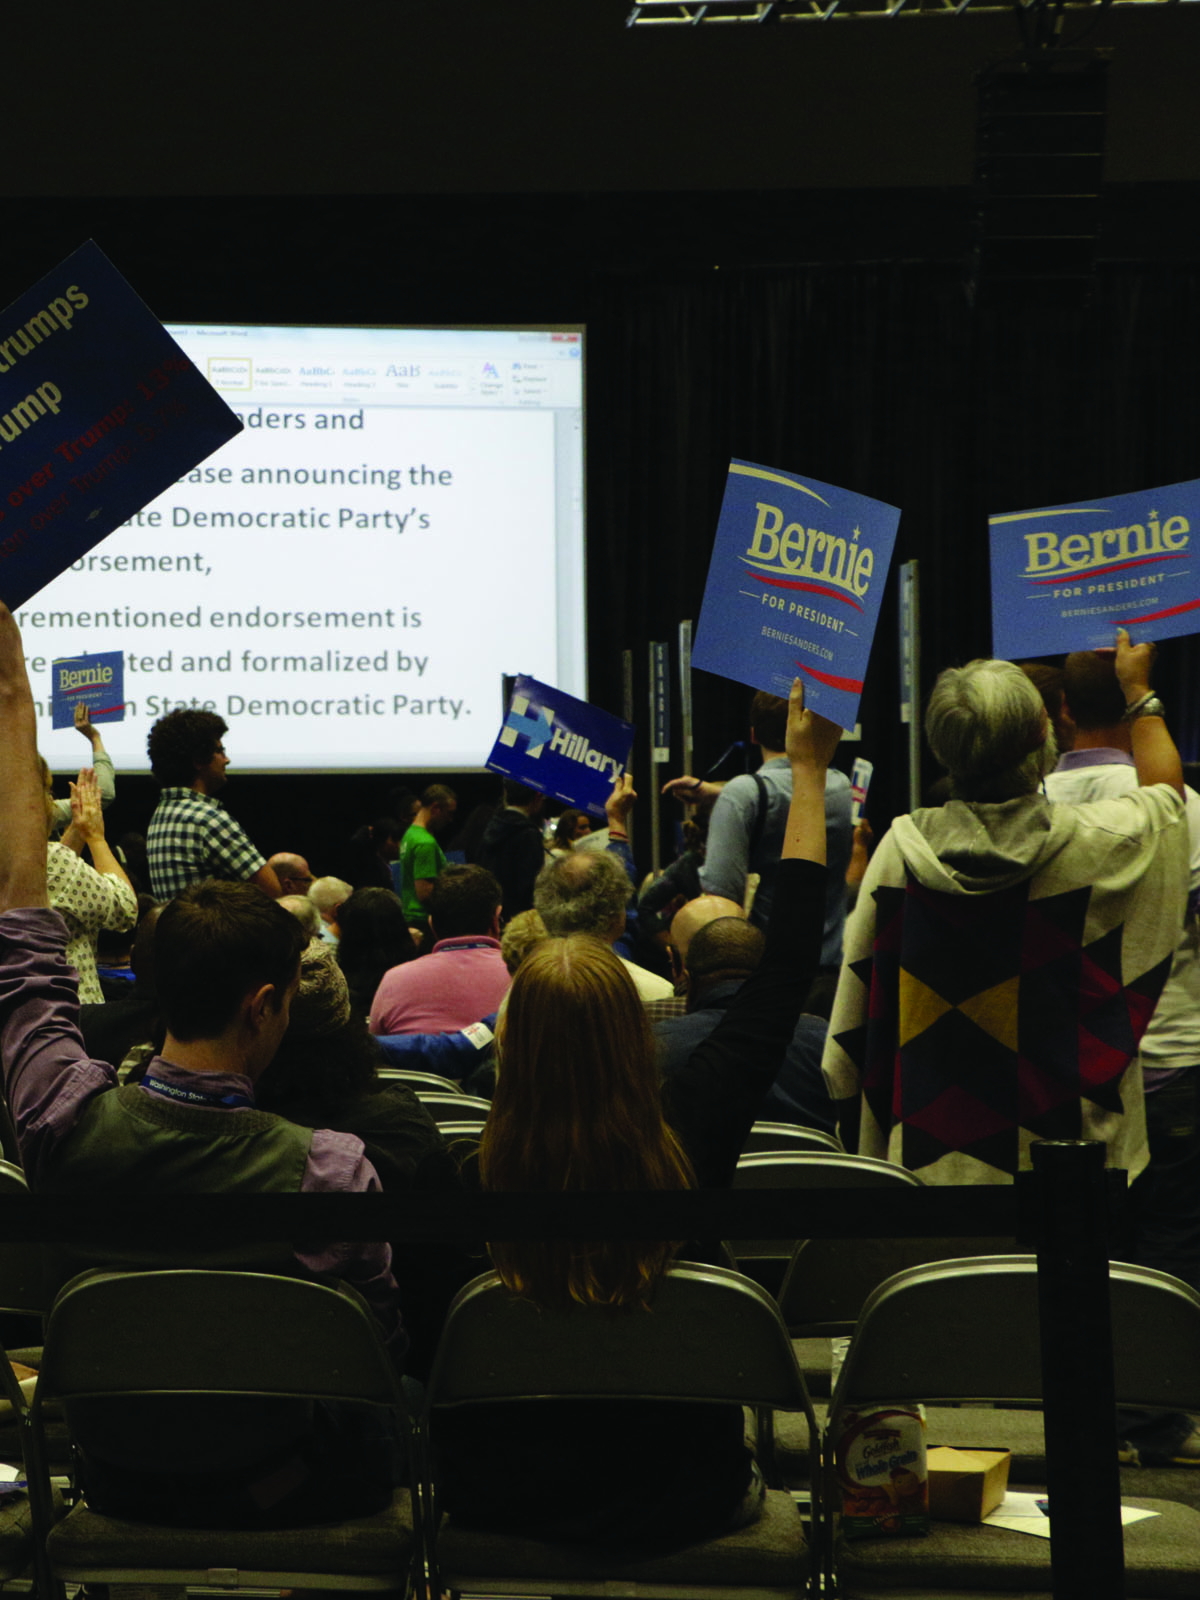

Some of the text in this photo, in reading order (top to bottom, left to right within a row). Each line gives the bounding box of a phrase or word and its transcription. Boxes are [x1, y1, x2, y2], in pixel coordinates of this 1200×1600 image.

[8, 462, 54, 506] over
[53, 399, 135, 462] Trump:
[137, 352, 190, 401] 13%
[314, 408, 364, 430] and
[241, 464, 401, 491] announcing
[408, 464, 452, 486] the
[31, 490, 71, 530] over
[172, 506, 329, 528] Democratic
[745, 501, 875, 598] Bernie
[1023, 509, 1191, 573] Bernie
[71, 553, 213, 576] orsement,
[1052, 573, 1166, 599] FOR PRESIDENT
[209, 605, 394, 628] endorsement
[403, 606, 422, 628] is
[761, 593, 845, 634] FOR PRESIDENT
[1060, 596, 1160, 618] BERNIESANDERS.COM
[760, 625, 835, 662] BERNIESANDERS.COM
[58, 662, 113, 690] Bernie
[181, 650, 232, 672] and
[241, 649, 388, 672] formalized
[397, 650, 429, 677] by
[227, 695, 384, 717] Democratic
[393, 694, 471, 720] Party.
[548, 727, 625, 784] Hillary
[149, 1078, 187, 1098] Washington
